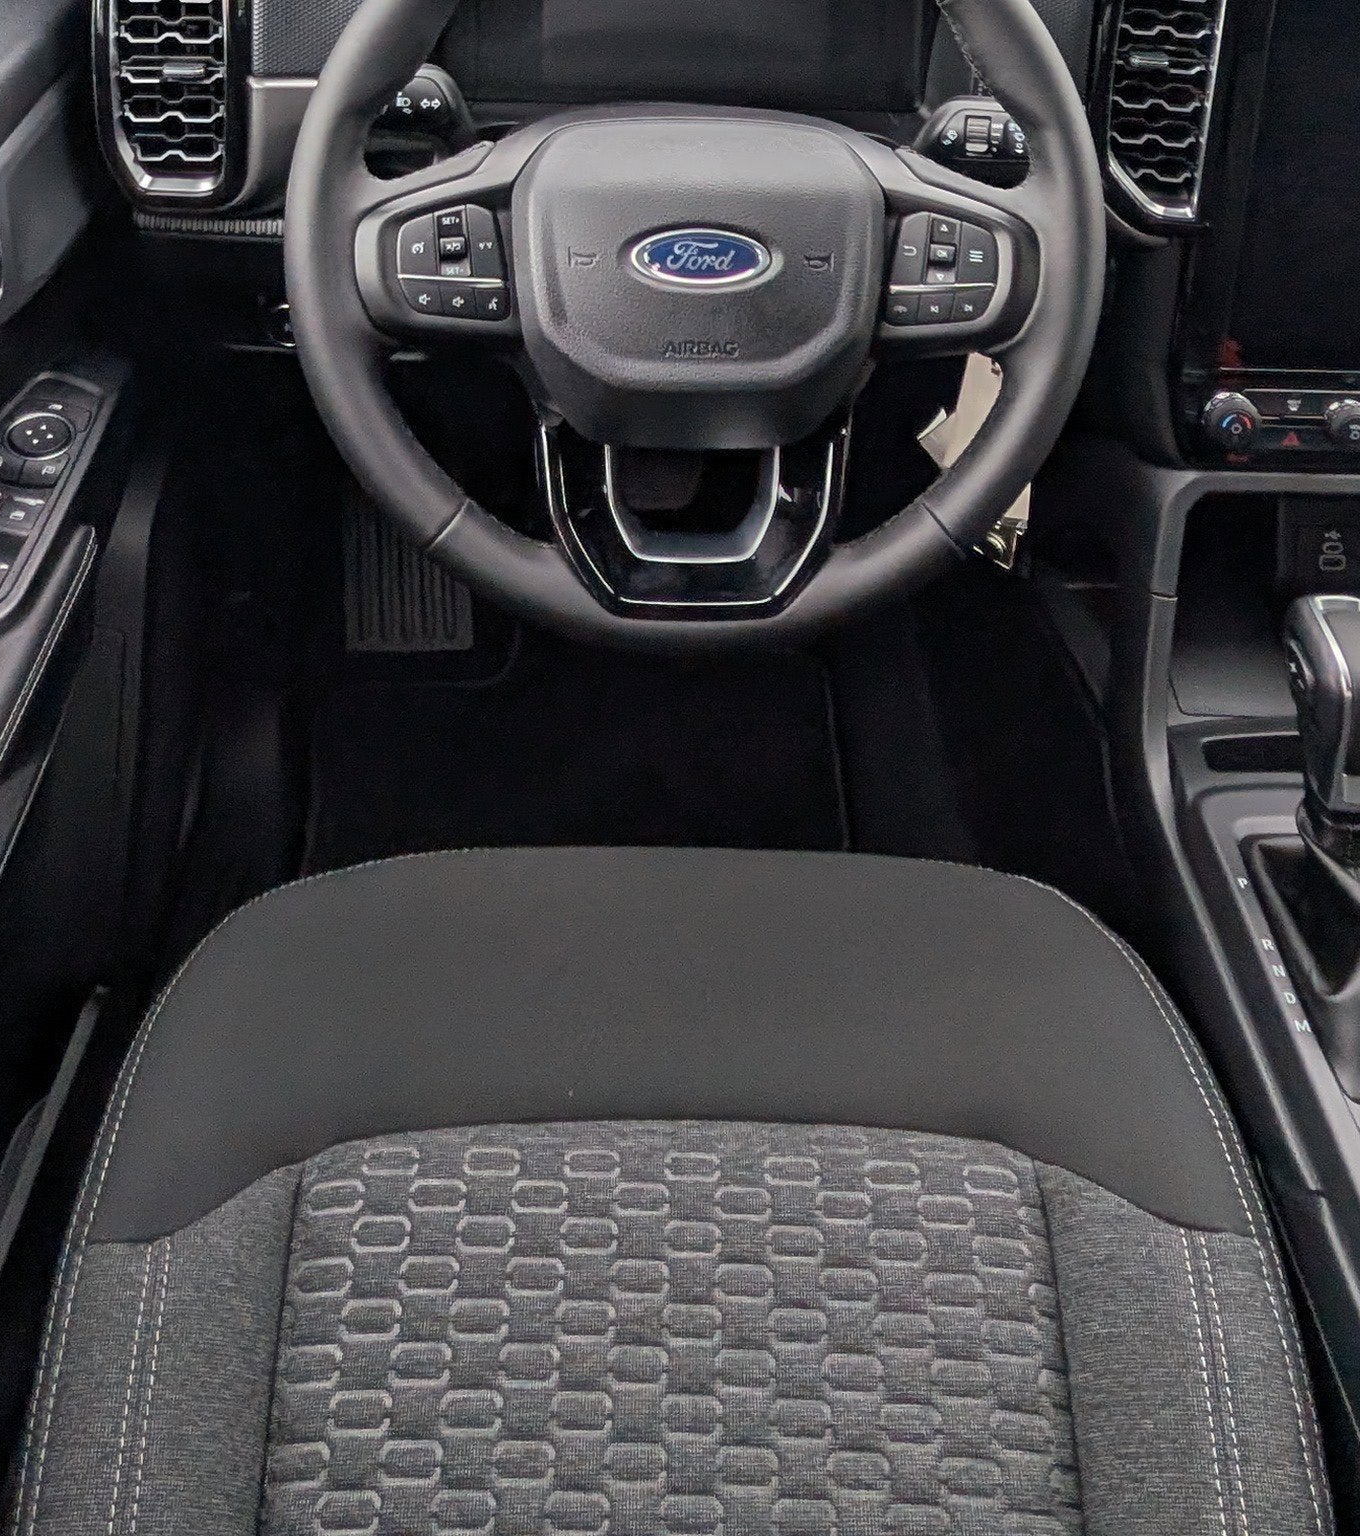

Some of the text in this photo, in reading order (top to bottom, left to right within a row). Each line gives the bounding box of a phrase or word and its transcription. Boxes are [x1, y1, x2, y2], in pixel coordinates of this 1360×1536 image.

[667, 241, 736, 271] Ford
[662, 341, 740, 359] AIRBAG
[1261, 938, 1274, 951] R
[1272, 965, 1286, 977] N
[1284, 992, 1296, 1004] D
[1295, 1020, 1311, 1033] M
